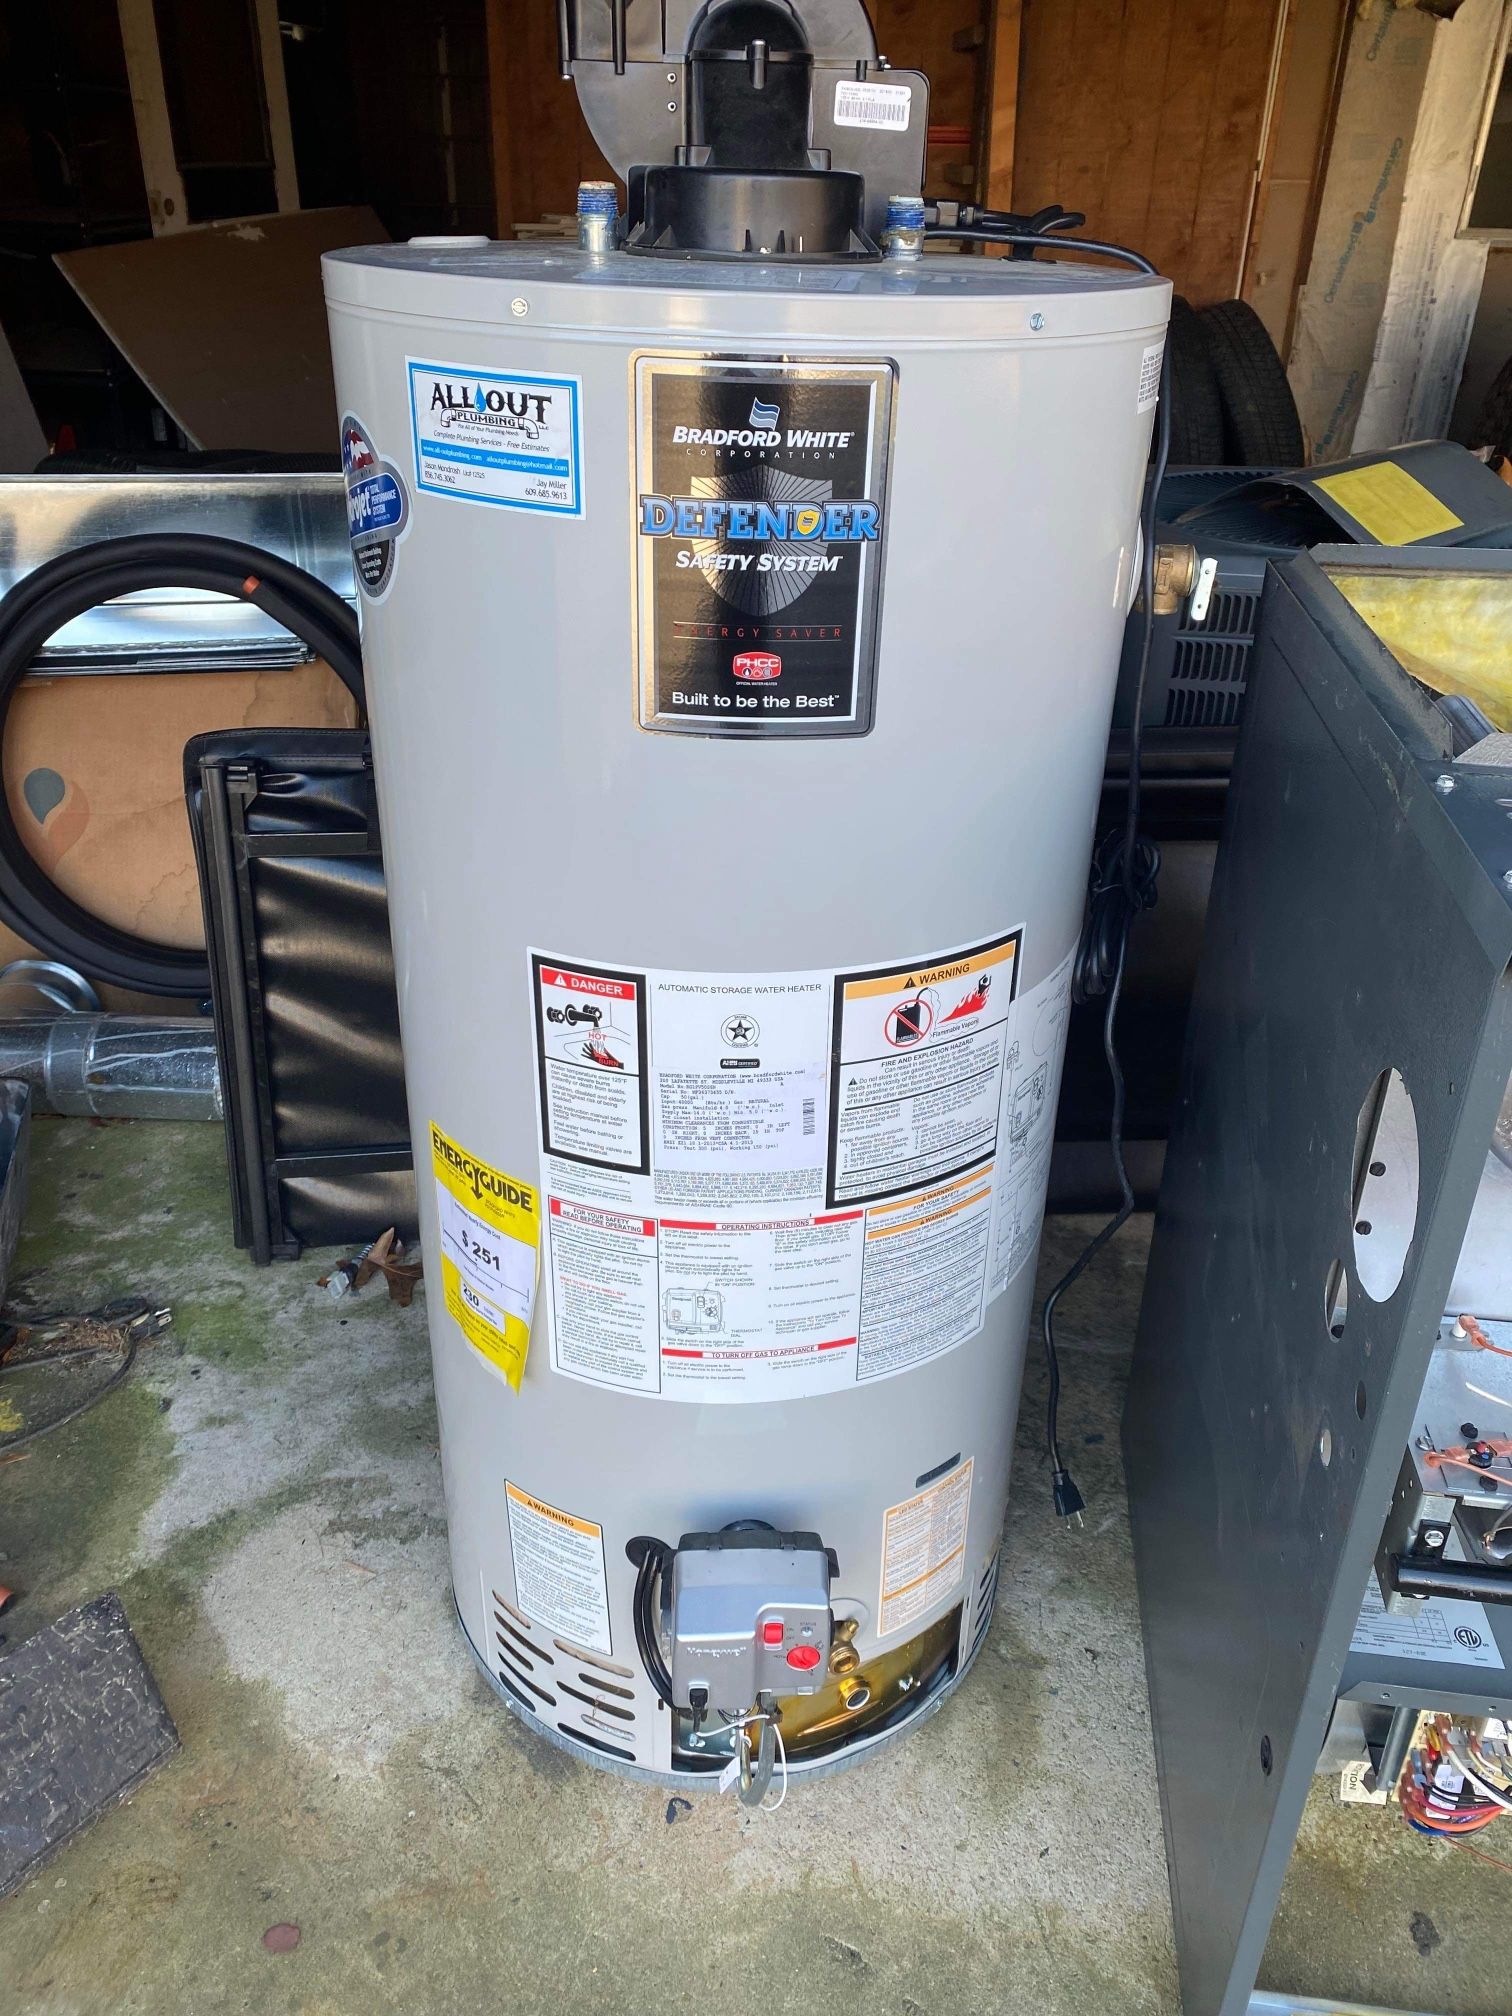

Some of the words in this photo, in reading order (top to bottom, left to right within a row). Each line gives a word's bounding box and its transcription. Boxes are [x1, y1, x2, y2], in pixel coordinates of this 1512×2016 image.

[430, 382, 475, 411] ALL
[486, 390, 552, 424] OUT
[457, 412, 516, 427] PLUMBING
[434, 430, 456, 441] Complete
[456, 433, 480, 444] Plumbing
[480, 437, 502, 446] Services
[507, 441, 519, 449] Free
[521, 443, 550, 452] Estimates
[672, 426, 781, 447] BRADFORD
[686, 448, 835, 460] CORPORATION
[424, 462, 437, 470] Jason
[536, 479, 547, 489] Jay
[548, 480, 567, 489] Miller
[525, 488, 567, 500] 609.685.9613
[639, 494, 880, 542] DEFENDER
[675, 550, 754, 571] SAFETY
[673, 625, 760, 637] ENERGY
[777, 628, 841, 639] SAVER
[736, 658, 779, 667] PHCC
[672, 691, 709, 706] Built
[713, 694, 730, 707] to
[736, 695, 757, 708] be
[763, 695, 790, 708] the
[919, 963, 970, 985] WARNING
[571, 978, 623, 996] DANGER
[658, 983, 709, 994] AUTOMATIC
[710, 986, 752, 994] STORAGE
[754, 985, 786, 994] WATER
[787, 983, 822, 993] HEATER
[932, 1022, 961, 1038] Flammable
[962, 1017, 979, 1029] Vapors
[588, 1032, 607, 1041] HOT
[881, 1057, 897, 1068] FIRE
[898, 1053, 912, 1064] AND
[913, 1046, 949, 1061] EXPLOSION
[949, 1038, 973, 1050] HAZARD
[598, 1058, 619, 1067] BURN
[551, 1064, 566, 1072] Water
[566, 1068, 597, 1079] temperature
[561, 1072, 576, 1080] cause
[925, 1198, 940, 1207] YOUR
[941, 1190, 960, 1203] SAFETY
[927, 1186, 954, 1200] WARNING
[563, 1210, 579, 1221] READ
[580, 1216, 604, 1226] BEFORE
[605, 1222, 642, 1233] OPERATING
[573, 1208, 585, 1216] FOR
[587, 1210, 604, 1220] YOUR
[605, 1215, 630, 1225] SAFETY
[721, 1222, 760, 1230] OPERATING
[761, 1219, 809, 1230] INSTRUCTIONS
[780, 1345, 814, 1356] APPLIANCE
[533, 1500, 575, 1527] WARNING
